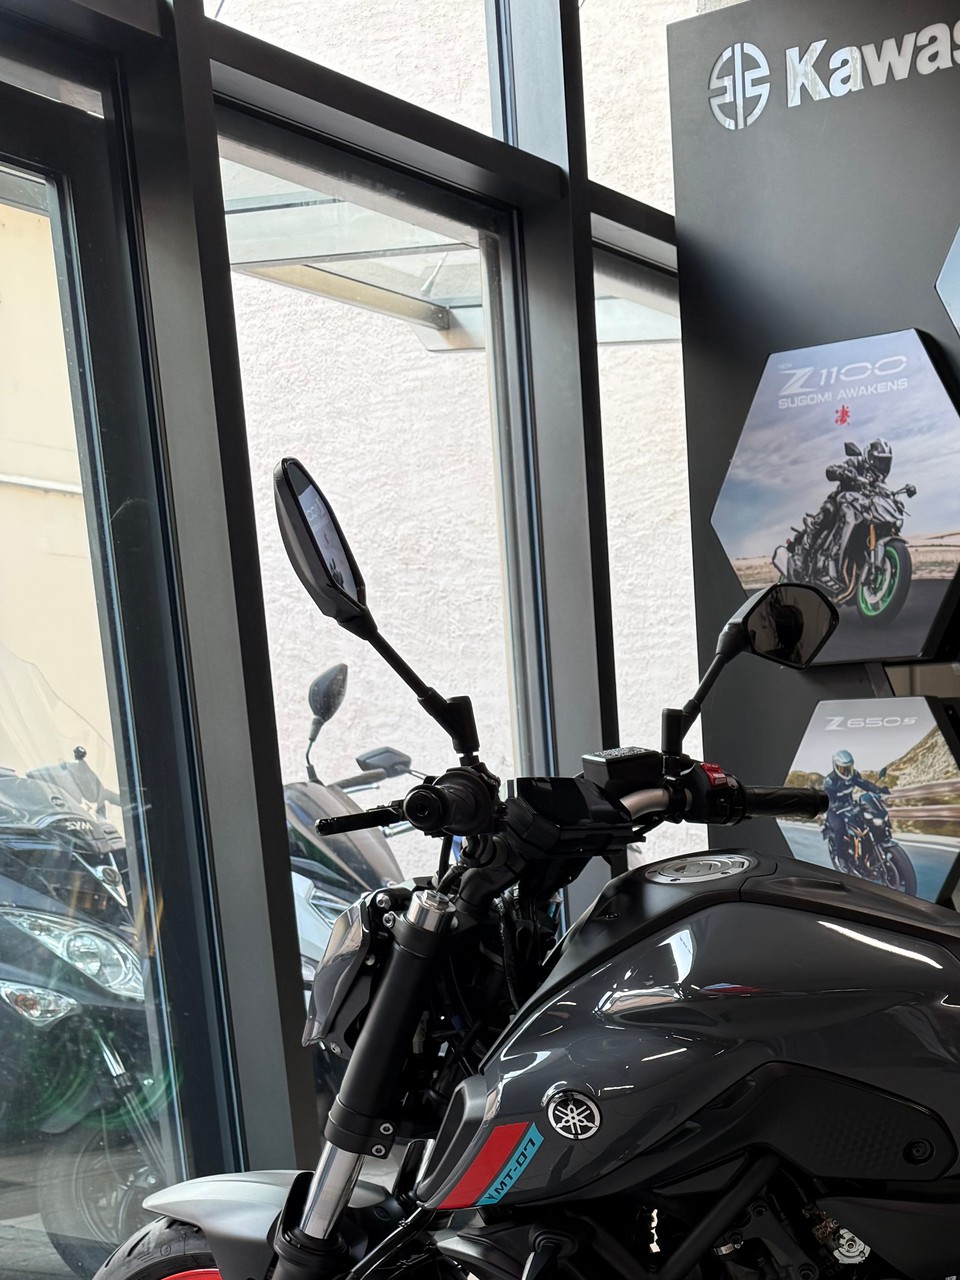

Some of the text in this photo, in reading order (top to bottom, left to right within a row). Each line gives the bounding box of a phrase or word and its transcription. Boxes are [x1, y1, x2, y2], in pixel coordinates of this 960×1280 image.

[778, 378, 908, 409] SUGOMI AWAKENS
[65, 821, 93, 830] SYM
[494, 1137, 536, 1195] MT-07
